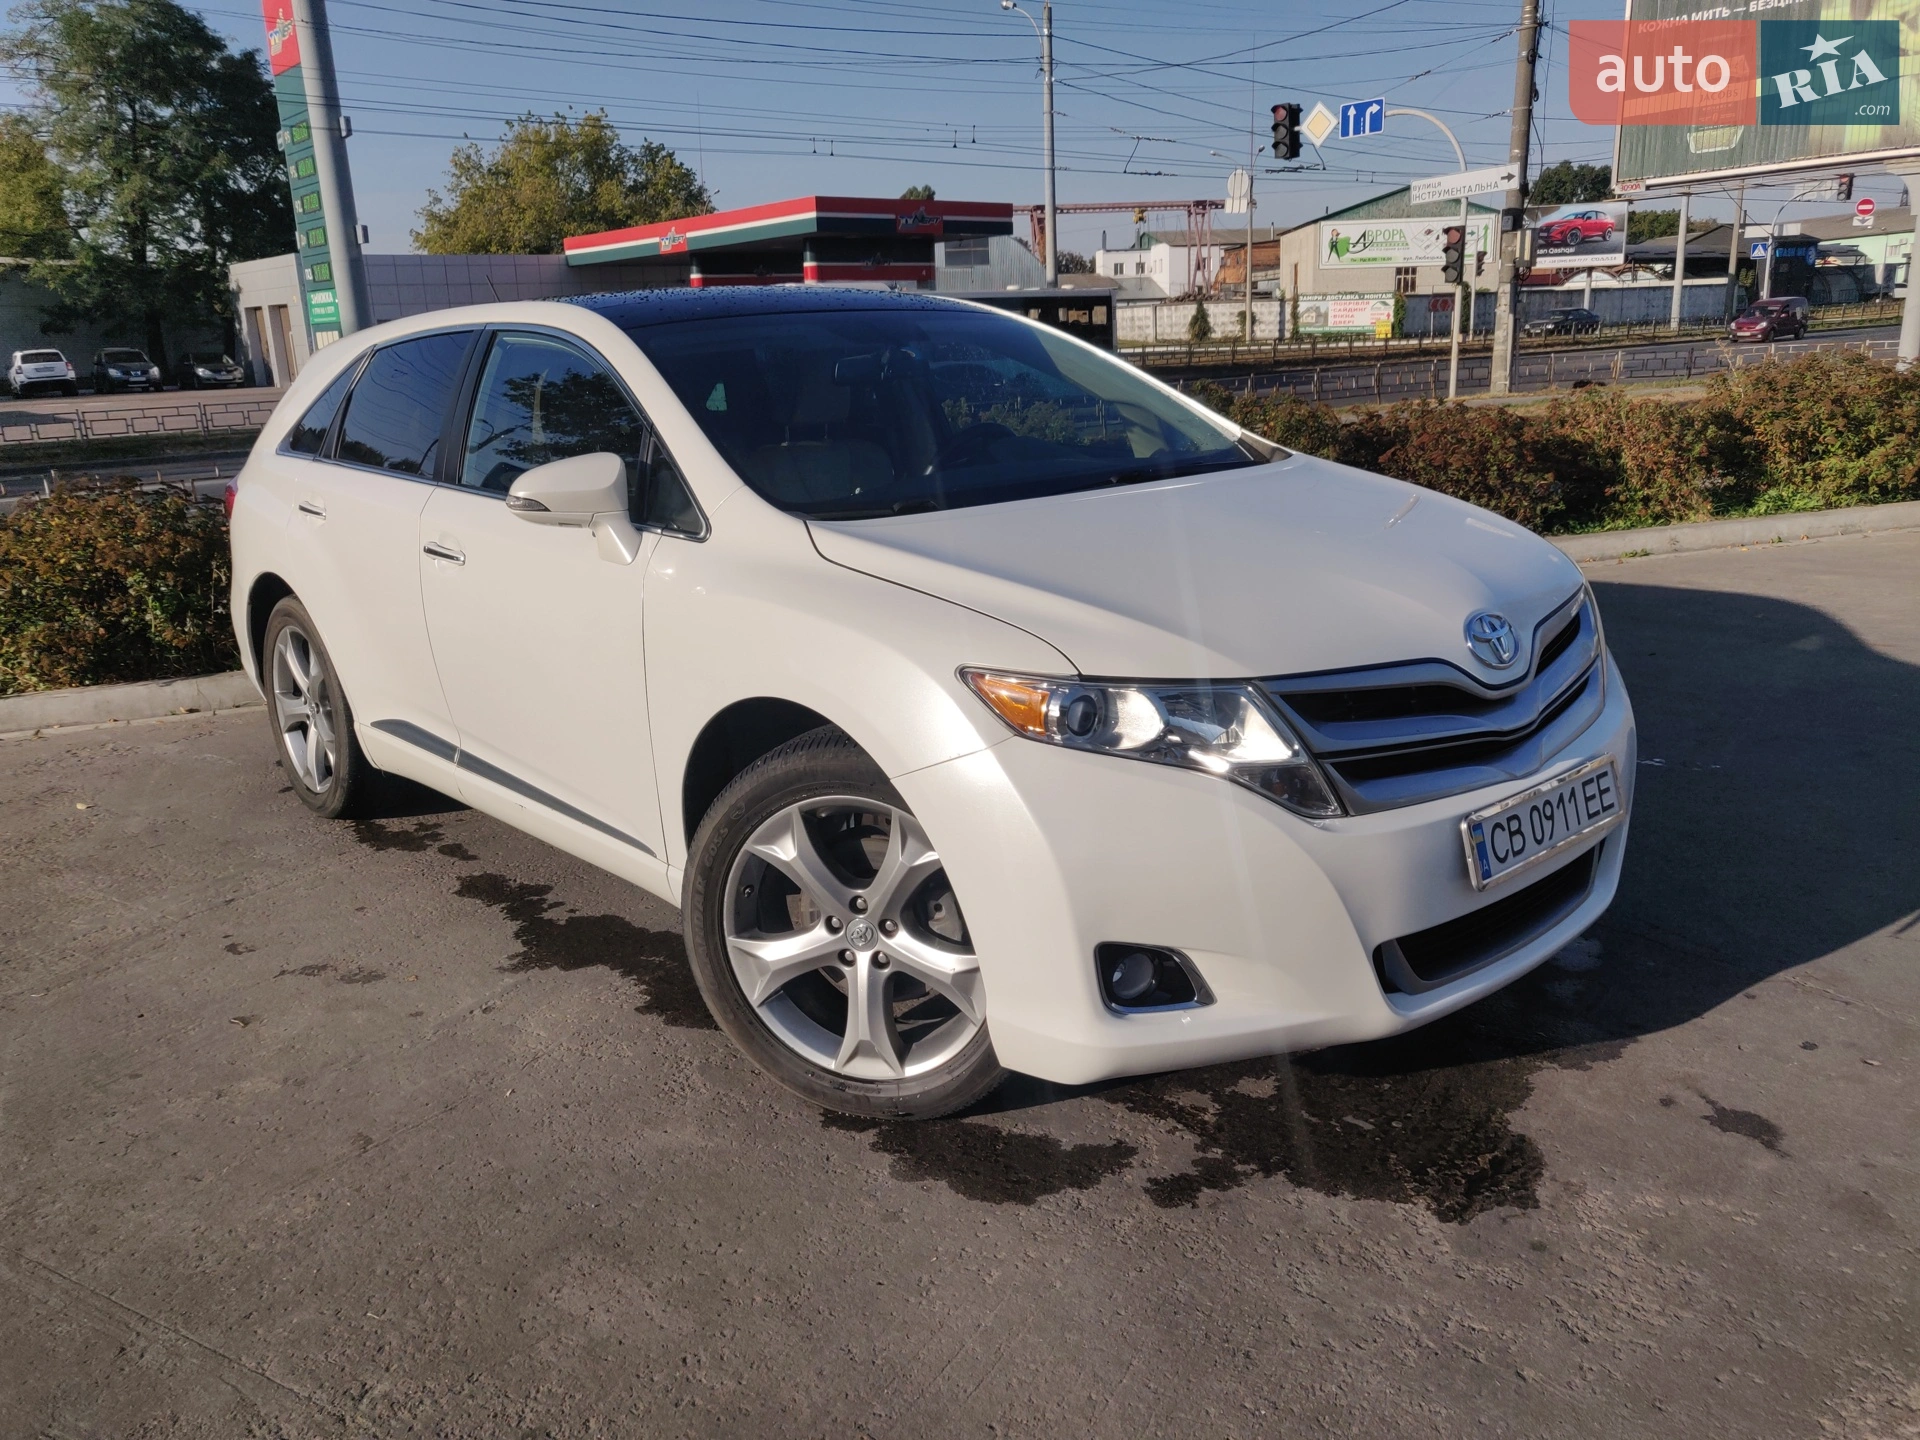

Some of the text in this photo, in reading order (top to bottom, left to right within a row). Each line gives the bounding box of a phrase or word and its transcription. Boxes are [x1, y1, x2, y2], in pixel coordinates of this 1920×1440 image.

[1638, 0, 1806, 34] КОЖНА МИТЬ БЕЗЦ
[1700, 89, 1738, 103] JACOBS
[1412, 181, 1499, 202] ІНСТРУМЕНТАЛЬНА
[1350, 228, 1407, 250] АВРОРА
[1548, 247, 1576, 255] Qashqai
[1490, 770, 1615, 864] CB 0911 EE
